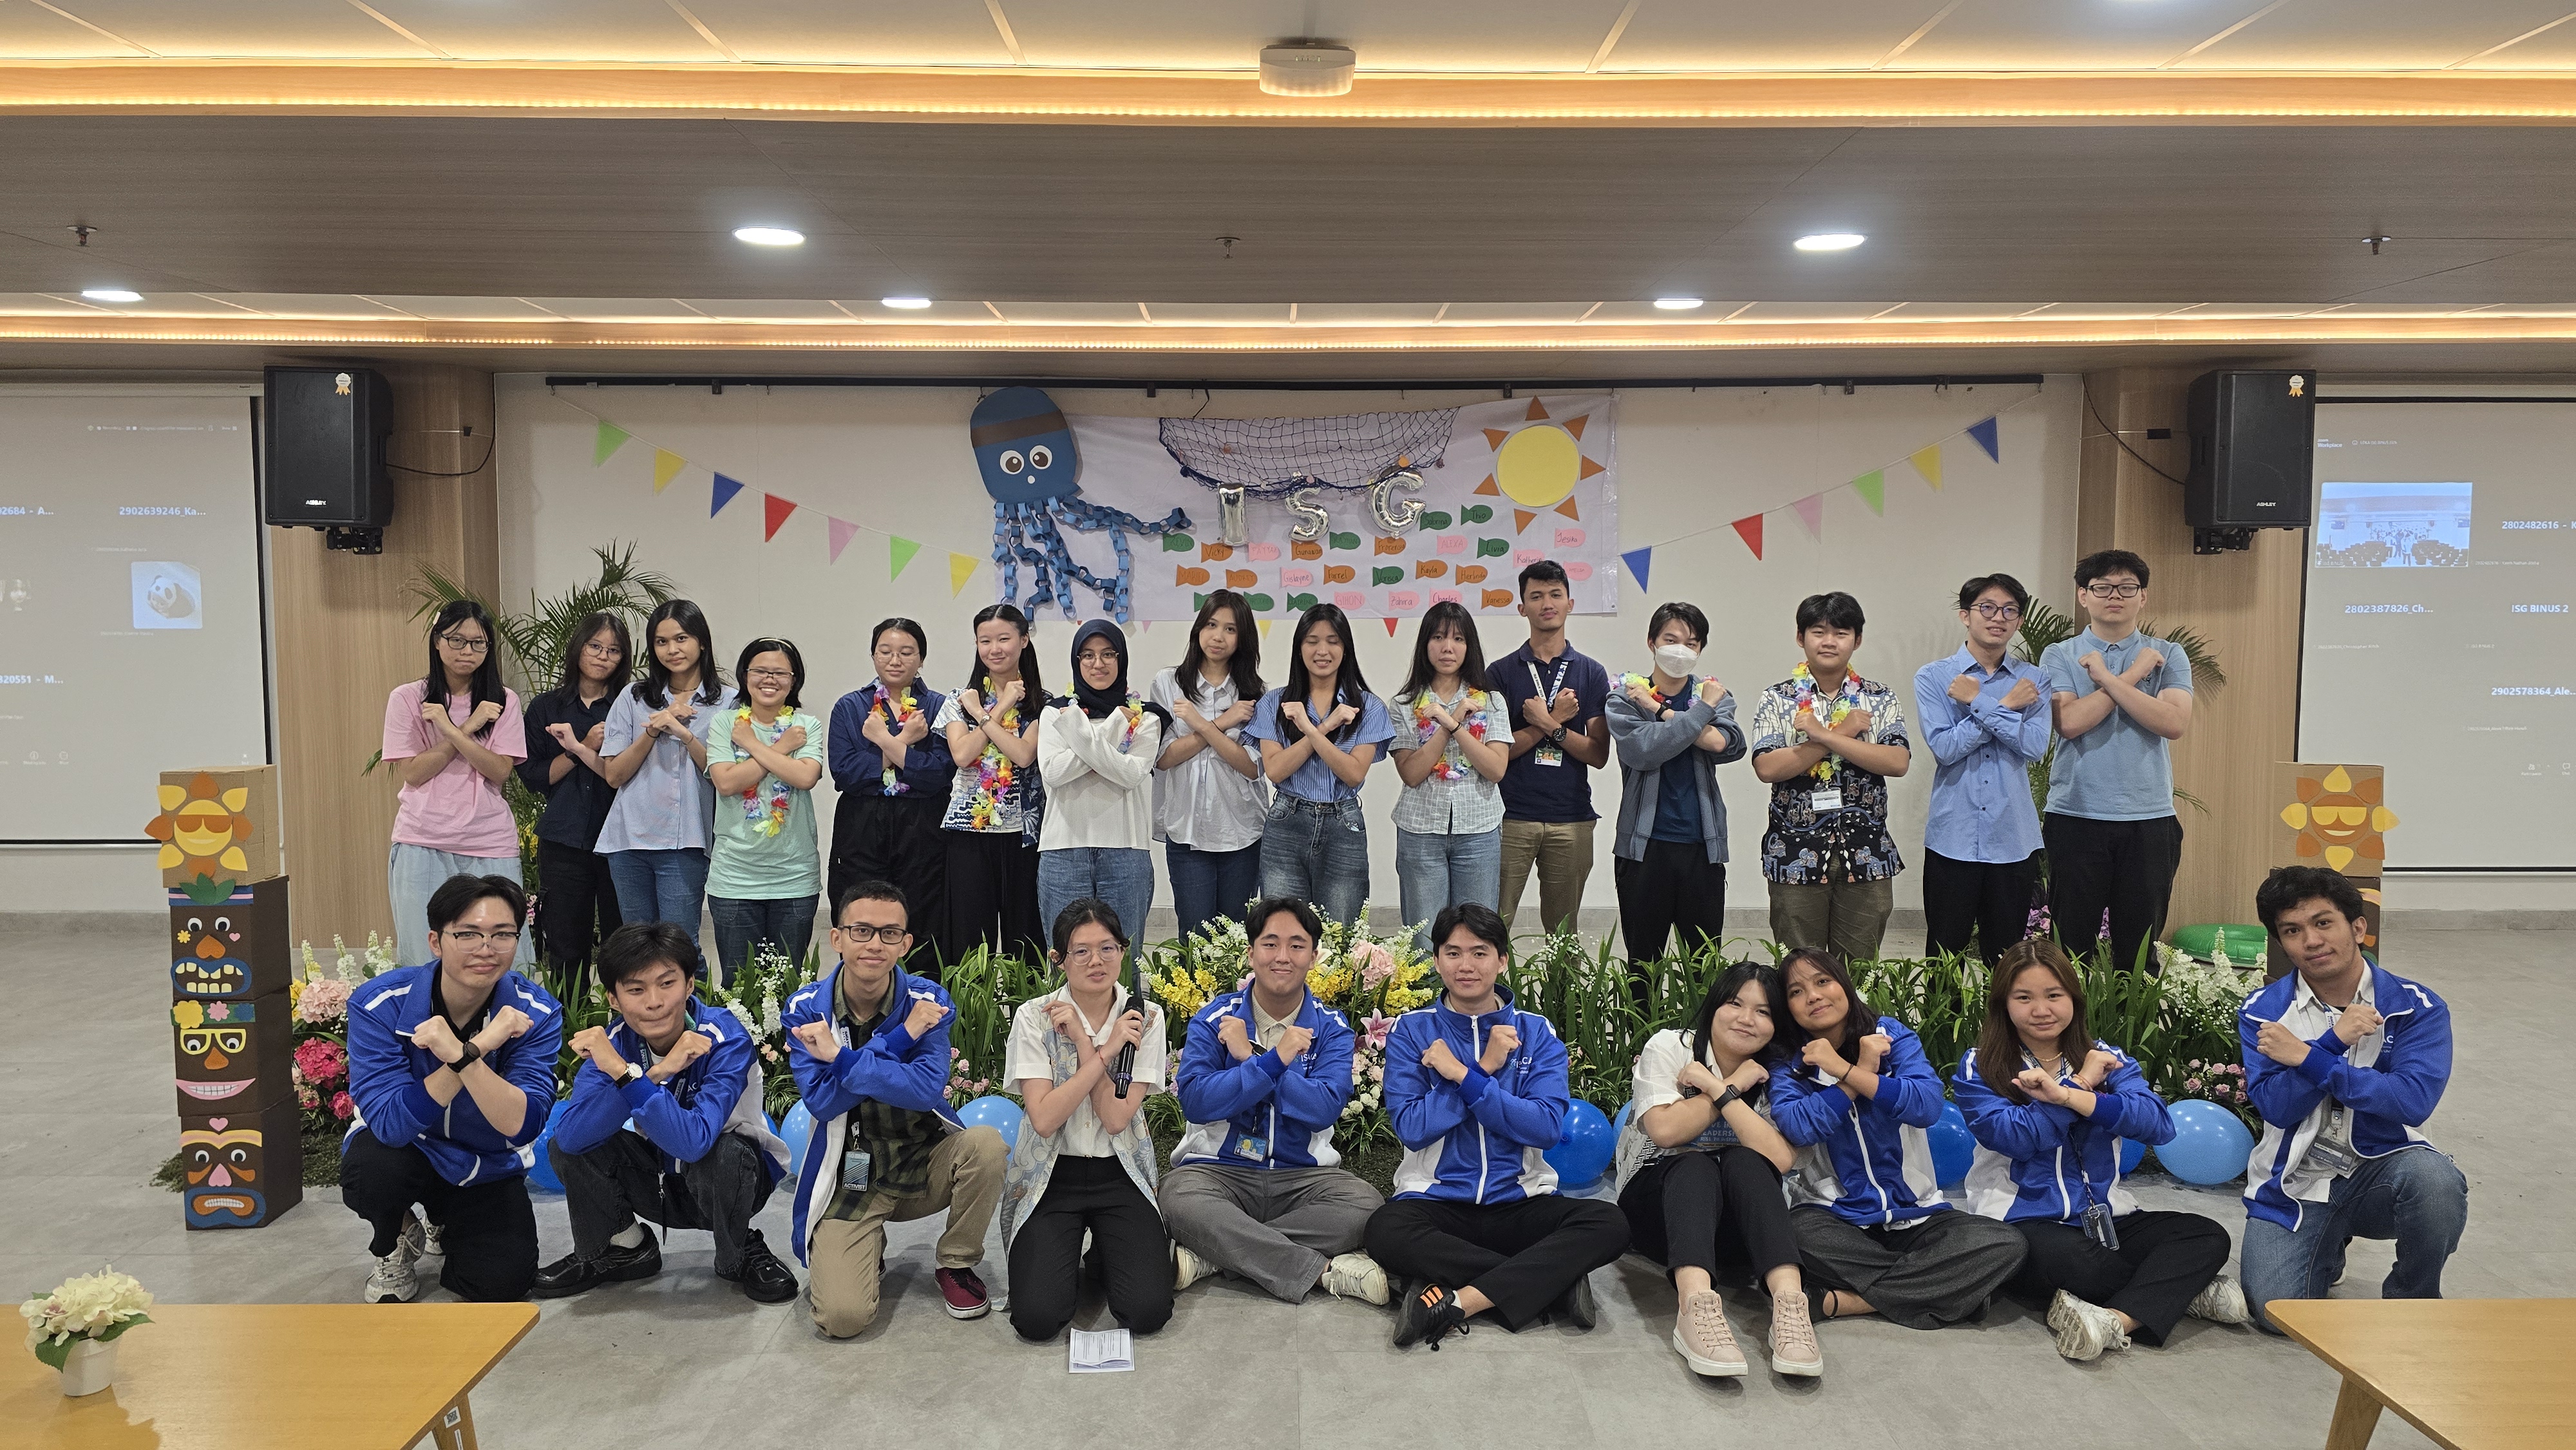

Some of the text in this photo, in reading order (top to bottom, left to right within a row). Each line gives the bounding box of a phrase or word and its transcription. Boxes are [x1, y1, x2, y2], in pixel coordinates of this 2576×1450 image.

[2501, 520, 2559, 529] 2802482616
[1441, 539, 1464, 549] ALEXA
[1486, 541, 1505, 552] Livia
[1205, 546, 1225, 558] Vicky
[1420, 564, 1438, 576] Kayla
[1335, 595, 1363, 606] GIHON
[1390, 596, 1413, 606] Zahira
[1486, 593, 1511, 605] Vanessa
[2345, 604, 2434, 614] 2802387826_Ch...
[2512, 604, 2528, 612] ISG
